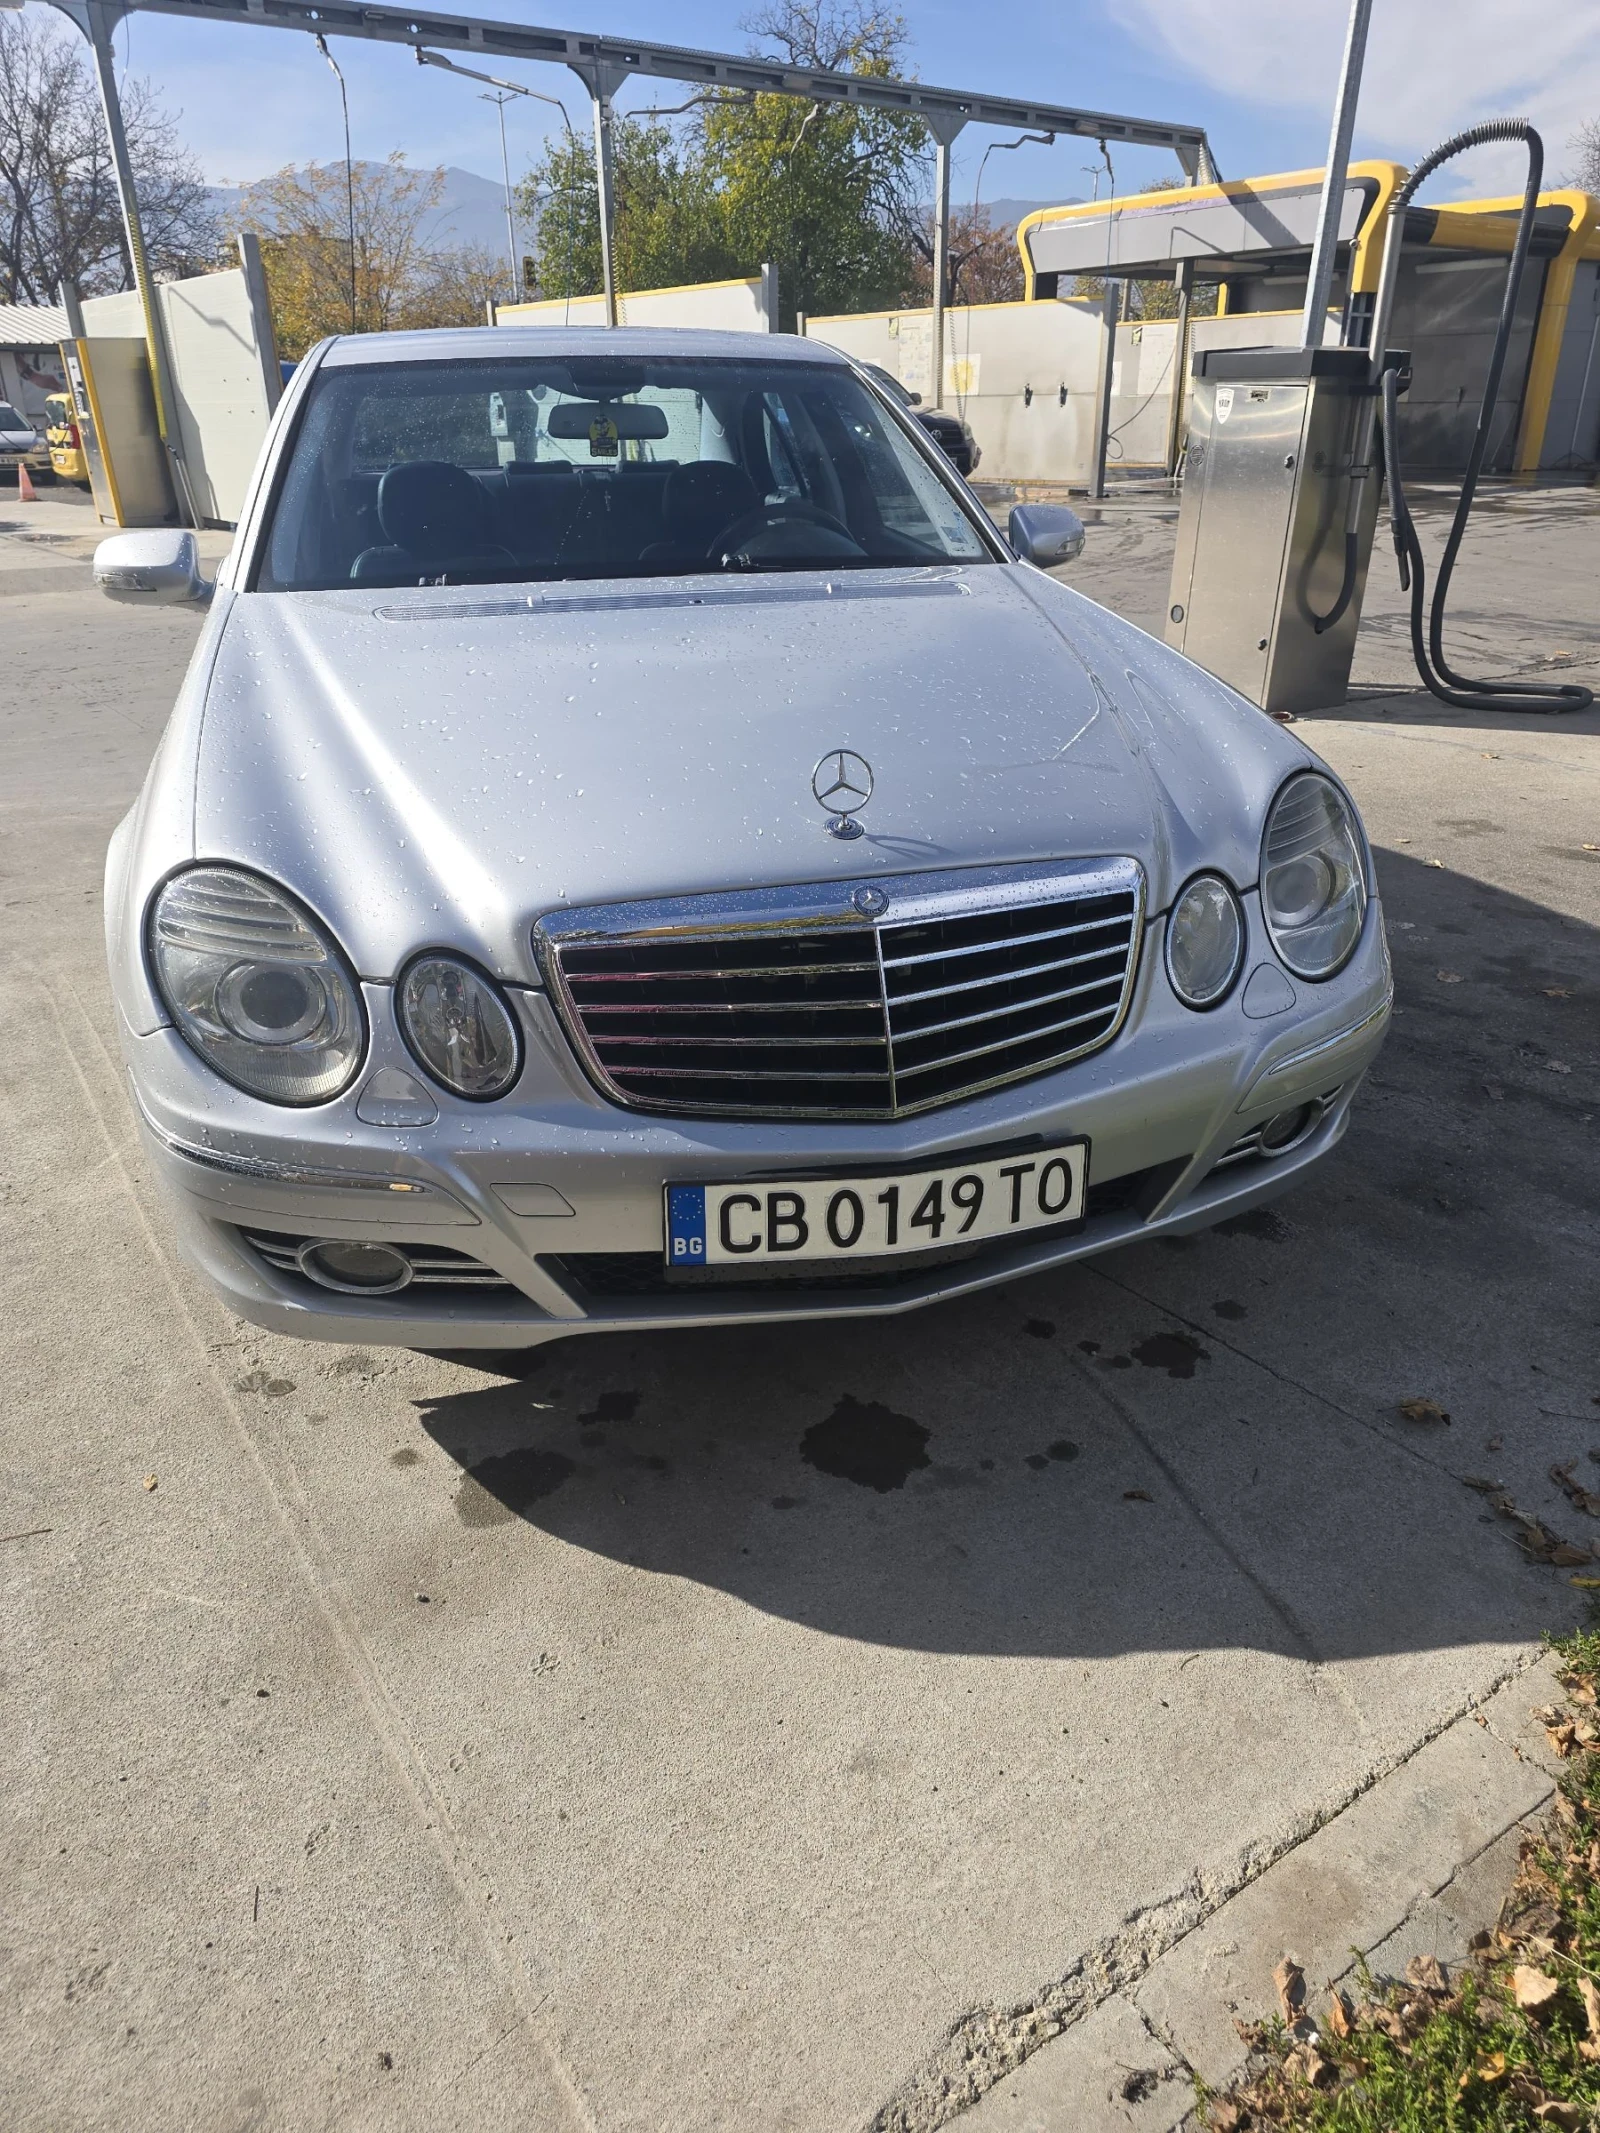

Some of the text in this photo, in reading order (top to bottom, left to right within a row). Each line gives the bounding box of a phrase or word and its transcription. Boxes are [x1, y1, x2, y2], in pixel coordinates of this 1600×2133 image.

[719, 1157, 1073, 1254] CB 0149 TO
[673, 1236, 703, 1256] BG
